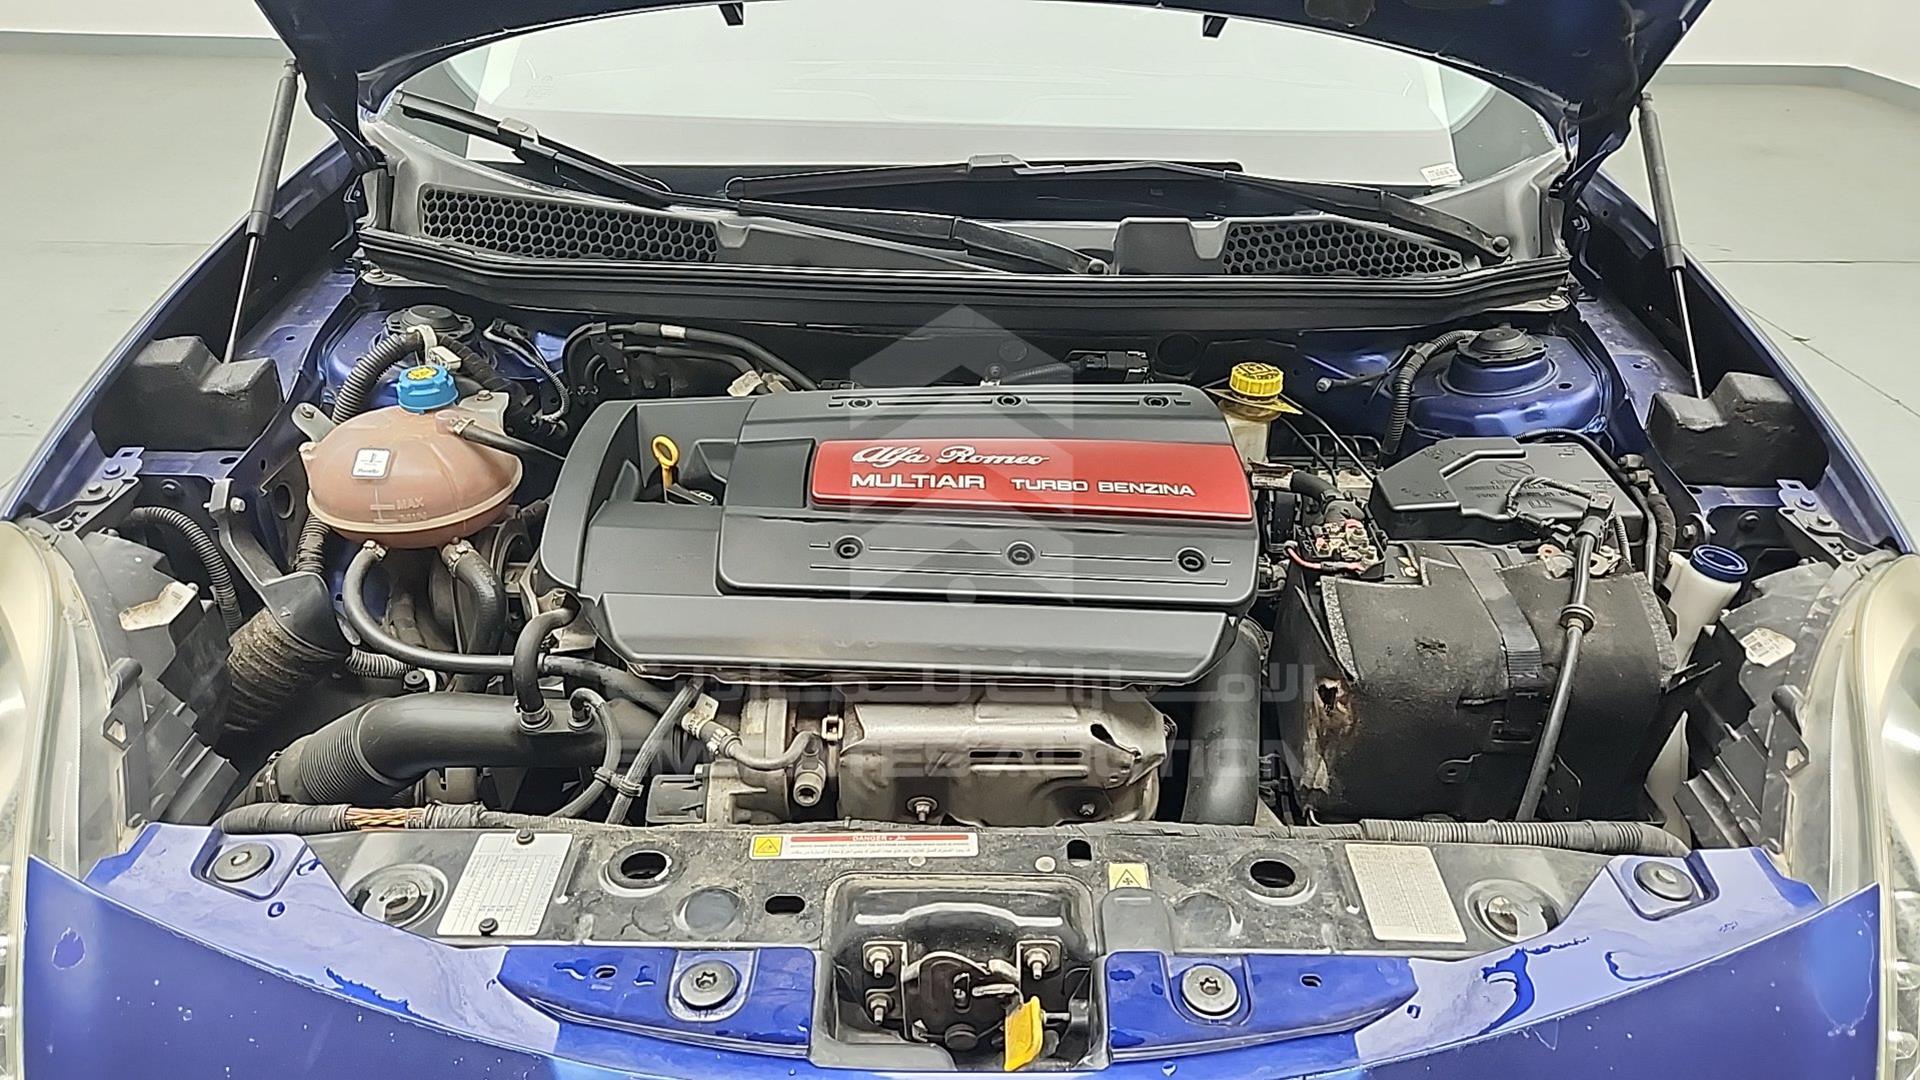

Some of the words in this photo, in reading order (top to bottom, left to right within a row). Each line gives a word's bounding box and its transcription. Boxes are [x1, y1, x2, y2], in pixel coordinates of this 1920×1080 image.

[852, 446, 930, 468] Alfa
[936, 445, 1049, 465] Romeo
[851, 474, 986, 489] MULTIAIR
[1011, 479, 1089, 491] TURBO
[1098, 481, 1196, 496] BENZINA
[396, 497, 425, 510] MAX
